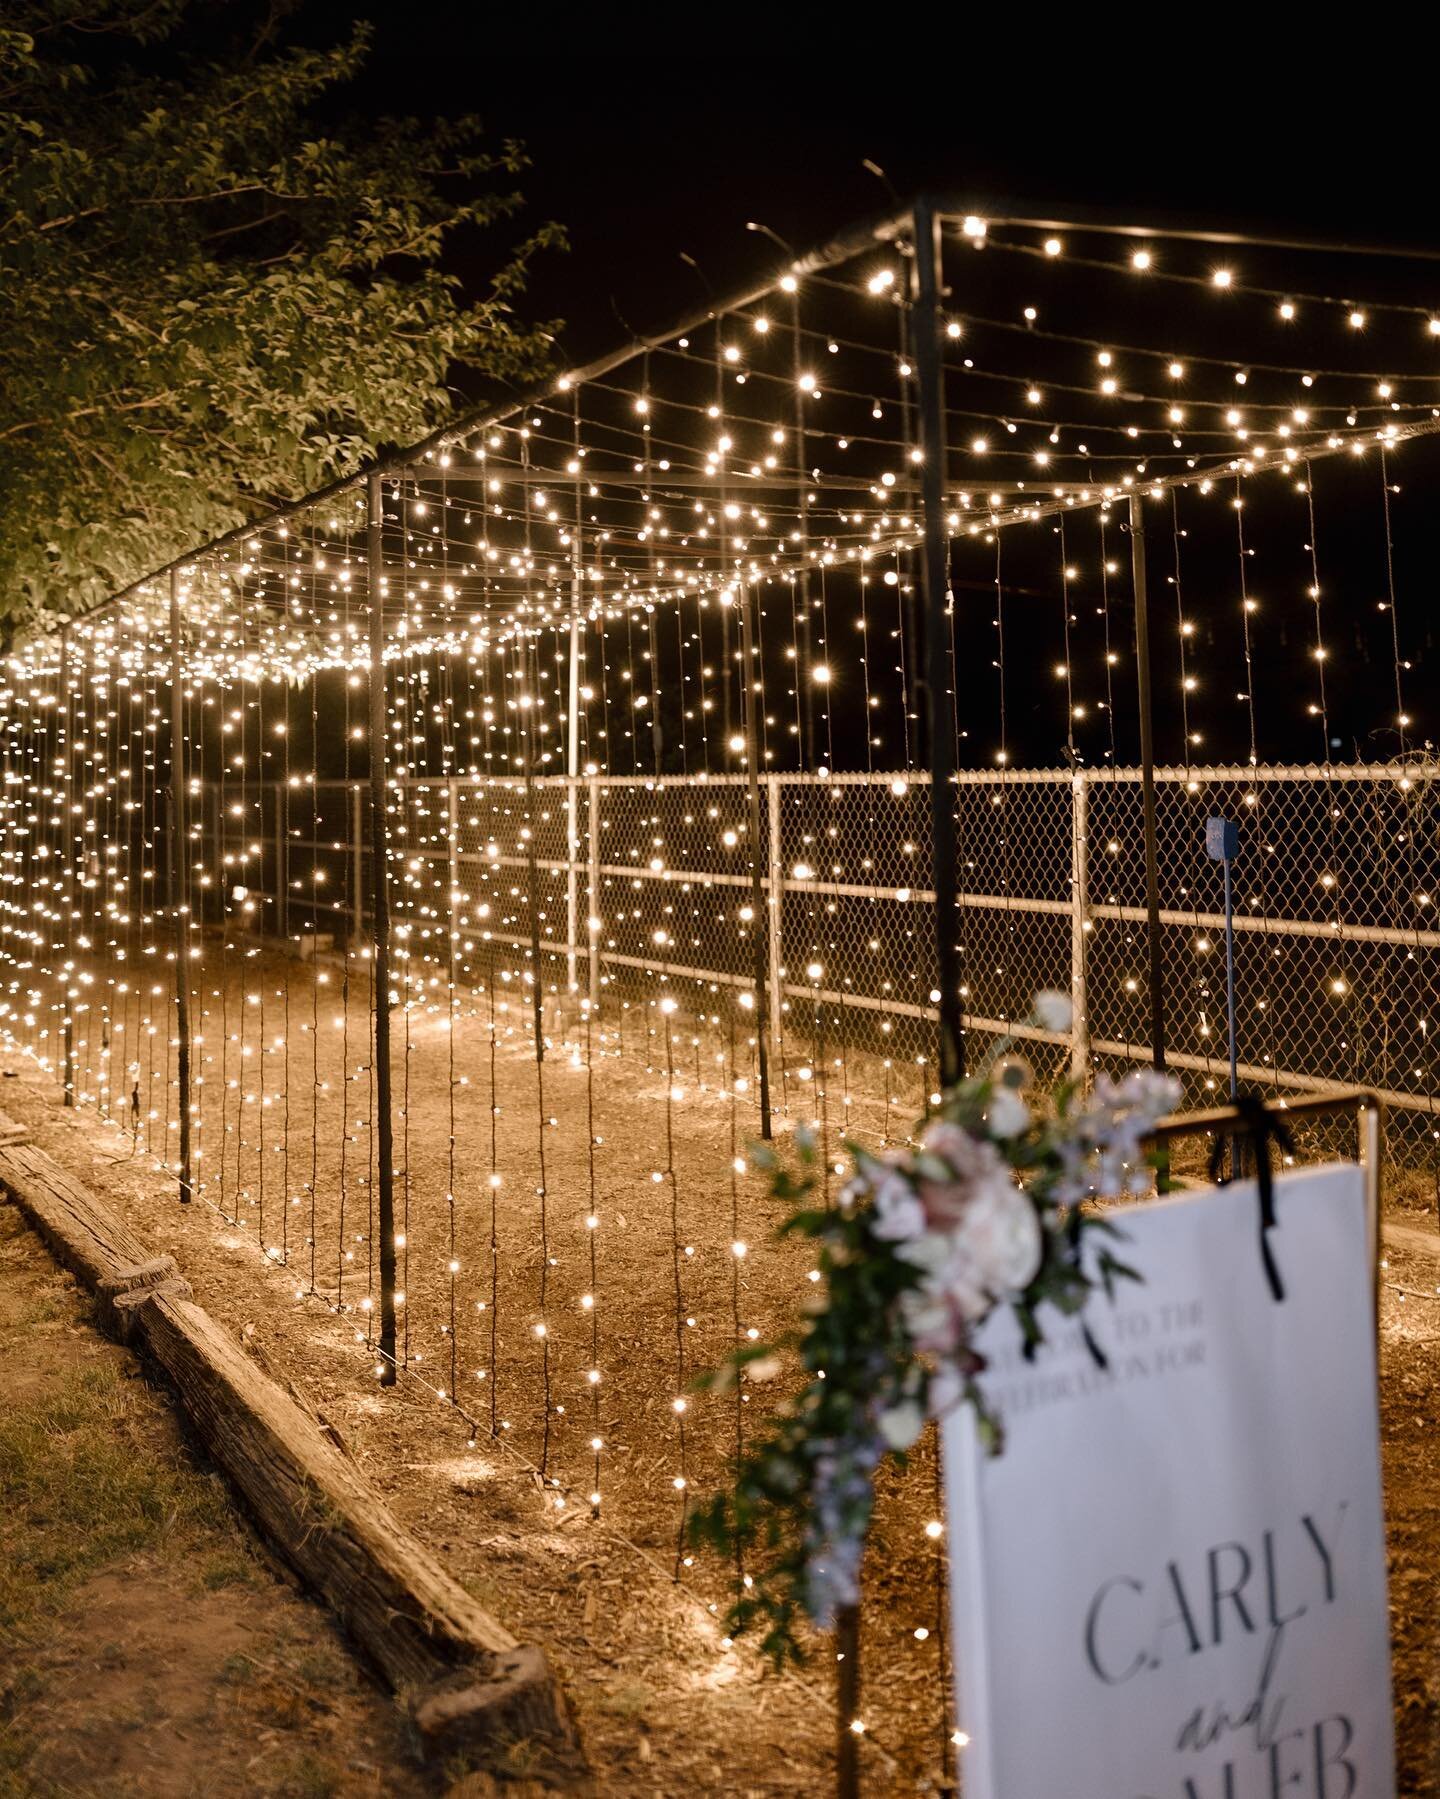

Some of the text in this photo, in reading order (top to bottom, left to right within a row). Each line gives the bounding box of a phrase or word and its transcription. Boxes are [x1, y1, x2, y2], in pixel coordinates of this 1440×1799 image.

[1115, 1298, 1204, 1341] TO THE
[1154, 1340, 1207, 1374] FOR
[1083, 1498, 1349, 1686] CARLY
[1174, 1628, 1288, 1752] and
